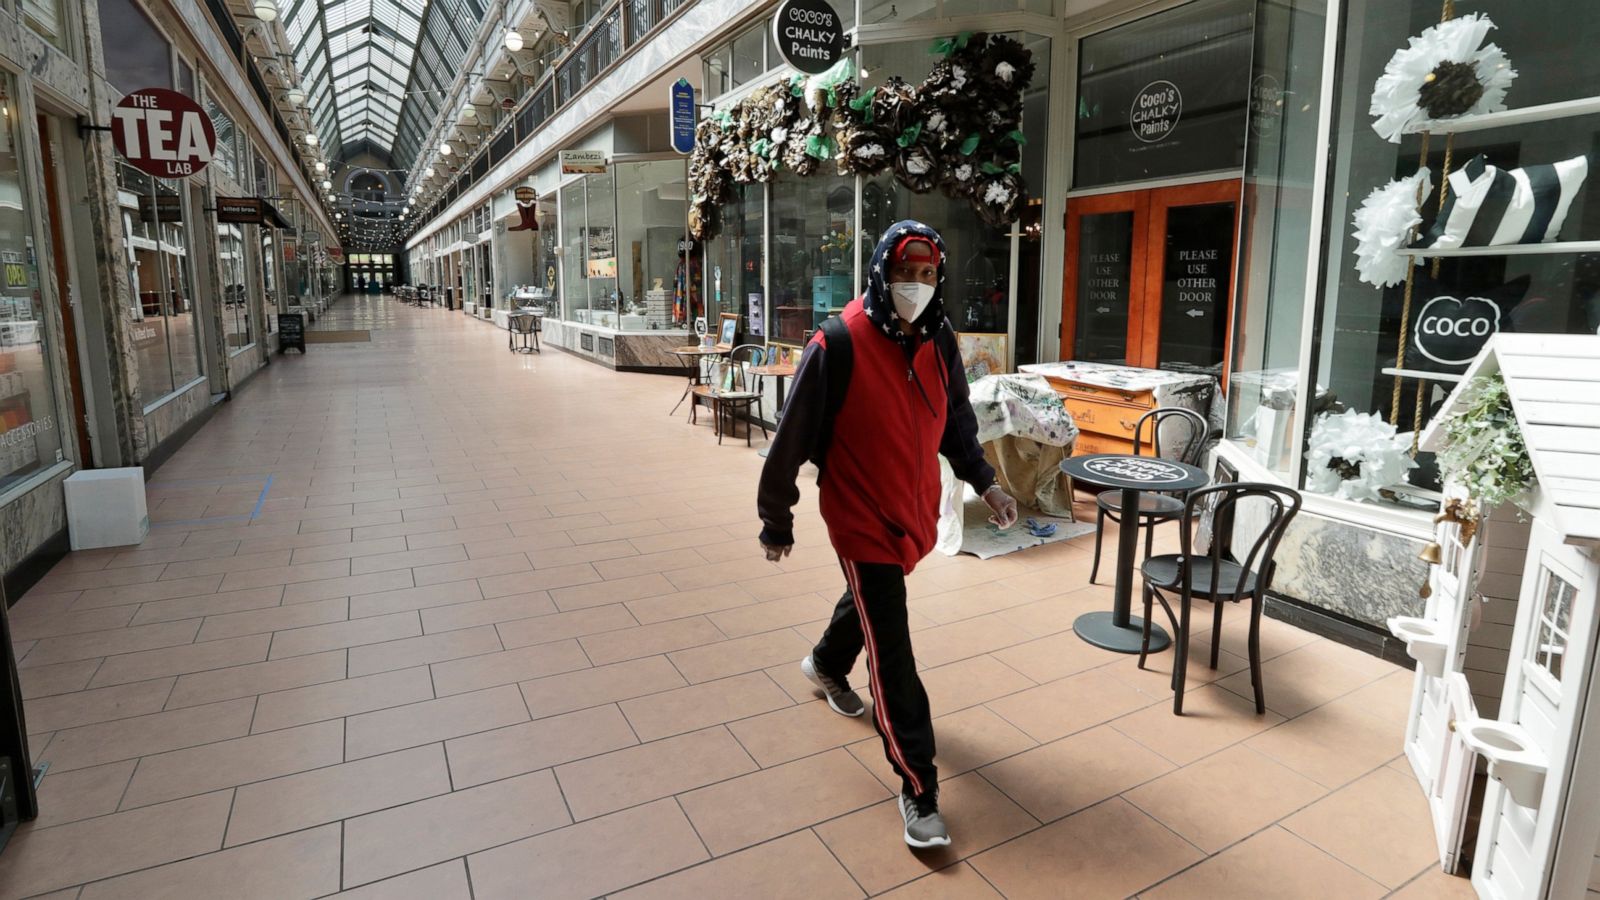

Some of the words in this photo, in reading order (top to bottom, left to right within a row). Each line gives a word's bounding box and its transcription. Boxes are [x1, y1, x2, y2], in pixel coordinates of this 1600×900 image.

[789, 7, 833, 27] COCO'S
[785, 26, 836, 44] CHALKY
[791, 41, 831, 60] Paints
[131, 94, 158, 108] THE
[1132, 102, 1179, 123] CHALKY
[112, 106, 212, 162] TEA
[1140, 119, 1170, 136] Paints
[166, 161, 192, 175] LAB
[1089, 253, 1120, 263] PLEASE
[1179, 250, 1218, 261] PLEASE
[6, 264, 27, 286] OPEN
[1096, 266, 1113, 275] USE
[1187, 264, 1208, 275] USE
[1088, 278, 1120, 288] OTHER
[1177, 278, 1217, 289] OTHER
[1089, 290, 1117, 300] DOOR
[1179, 291, 1213, 302] DOOR
[1422, 316, 1490, 337] COCO
[0, 415, 53, 449] ACCESSORIES
